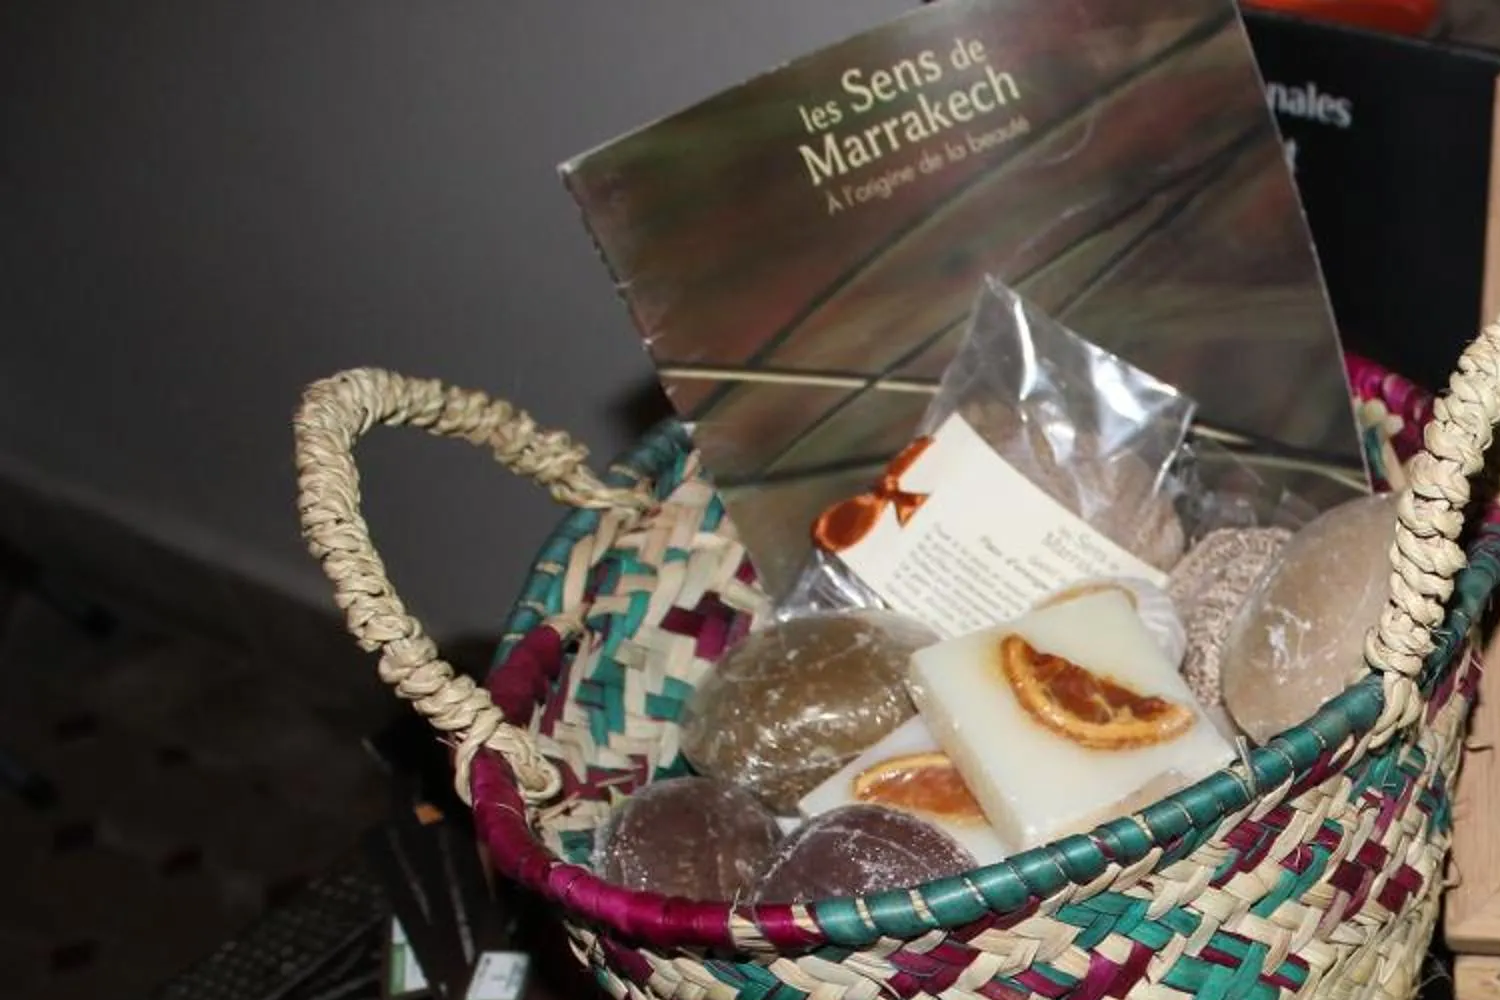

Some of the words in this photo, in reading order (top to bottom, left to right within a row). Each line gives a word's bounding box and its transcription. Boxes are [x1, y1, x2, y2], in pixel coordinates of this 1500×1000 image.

[798, 65, 1021, 186] Marrakech
[799, 100, 844, 133] les
[840, 50, 943, 112] Sens
[949, 37, 988, 70] de
